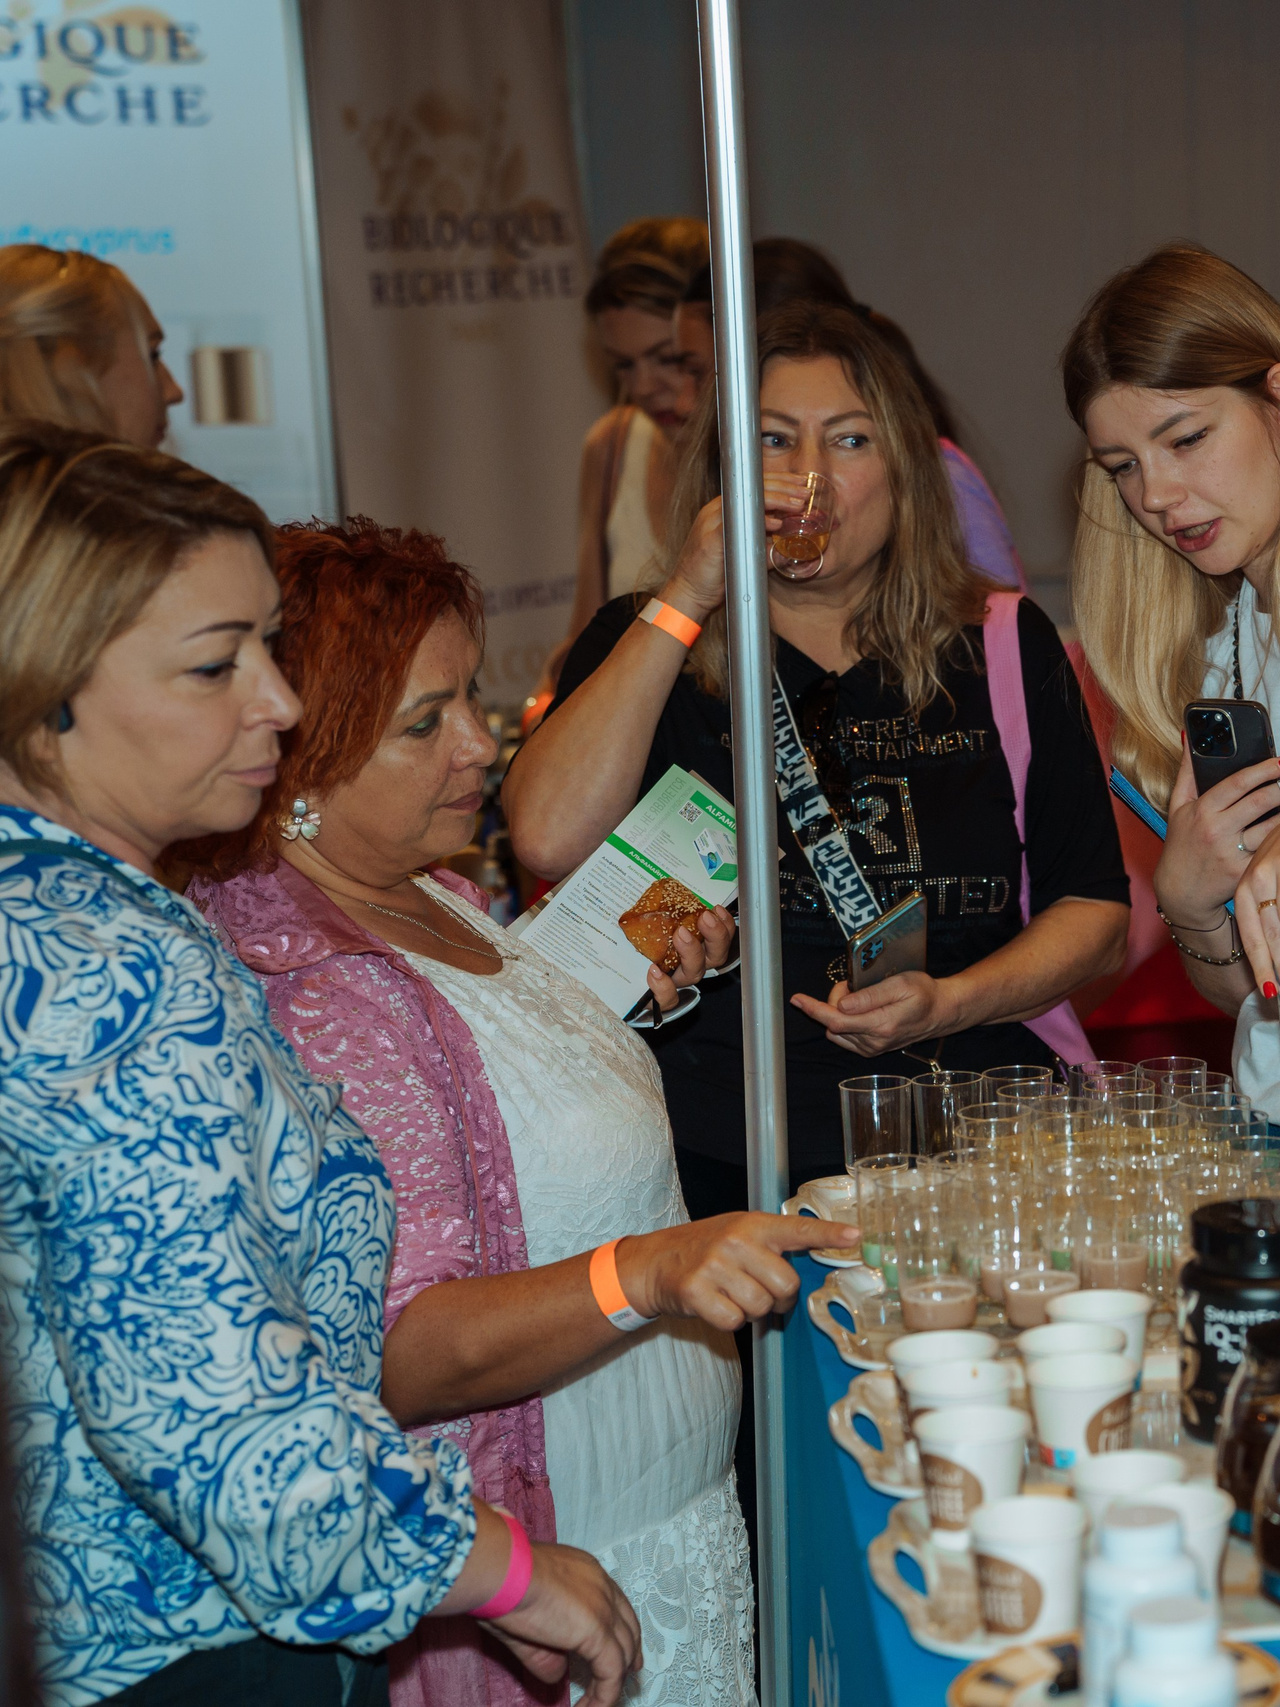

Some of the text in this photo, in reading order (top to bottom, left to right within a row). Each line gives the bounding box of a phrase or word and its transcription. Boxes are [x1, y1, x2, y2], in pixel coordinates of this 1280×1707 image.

[0, 81, 212, 127] RCHE
[370, 263, 578, 307] RECHERCHE
[624, 776, 687, 844] БАД, НЕ ЯВЛЯЕТСЯ
